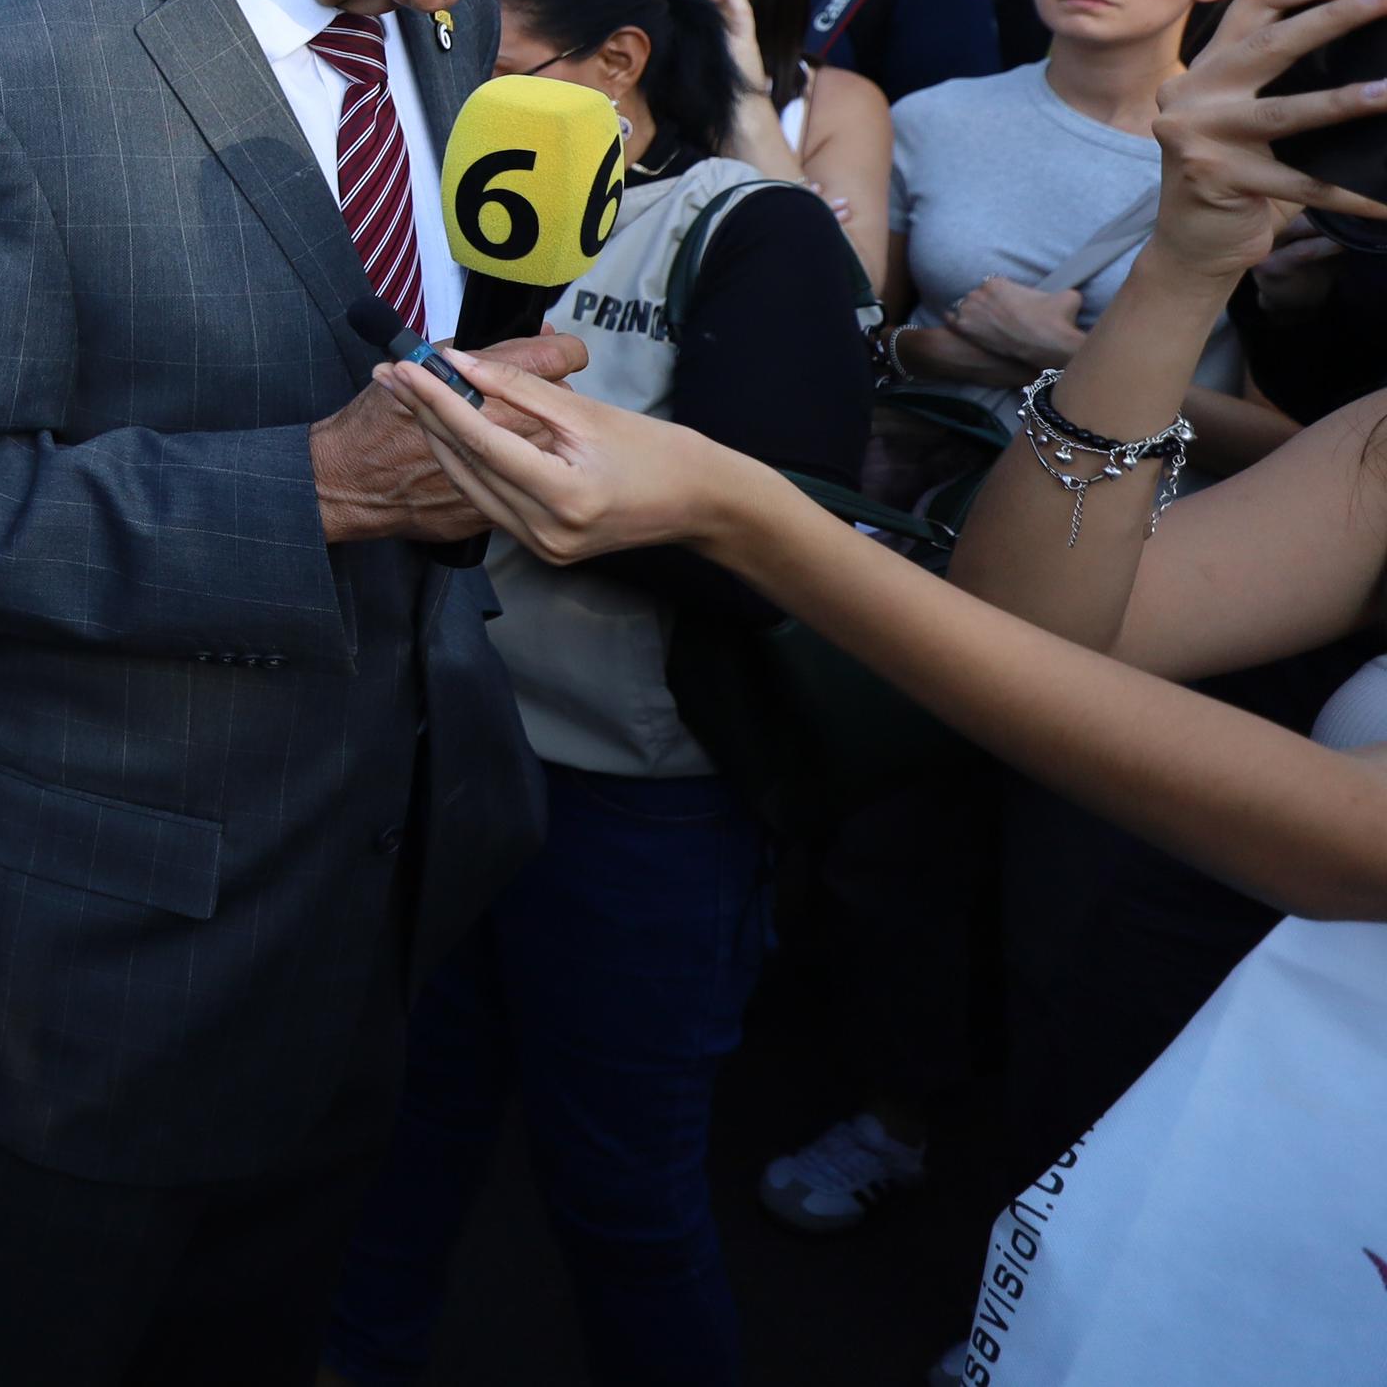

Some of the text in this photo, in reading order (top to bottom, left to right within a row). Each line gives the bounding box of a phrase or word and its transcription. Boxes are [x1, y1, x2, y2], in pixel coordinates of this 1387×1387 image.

[437, 23, 452, 50] 6
[455, 149, 540, 261] 6
[579, 133, 623, 258] 6
